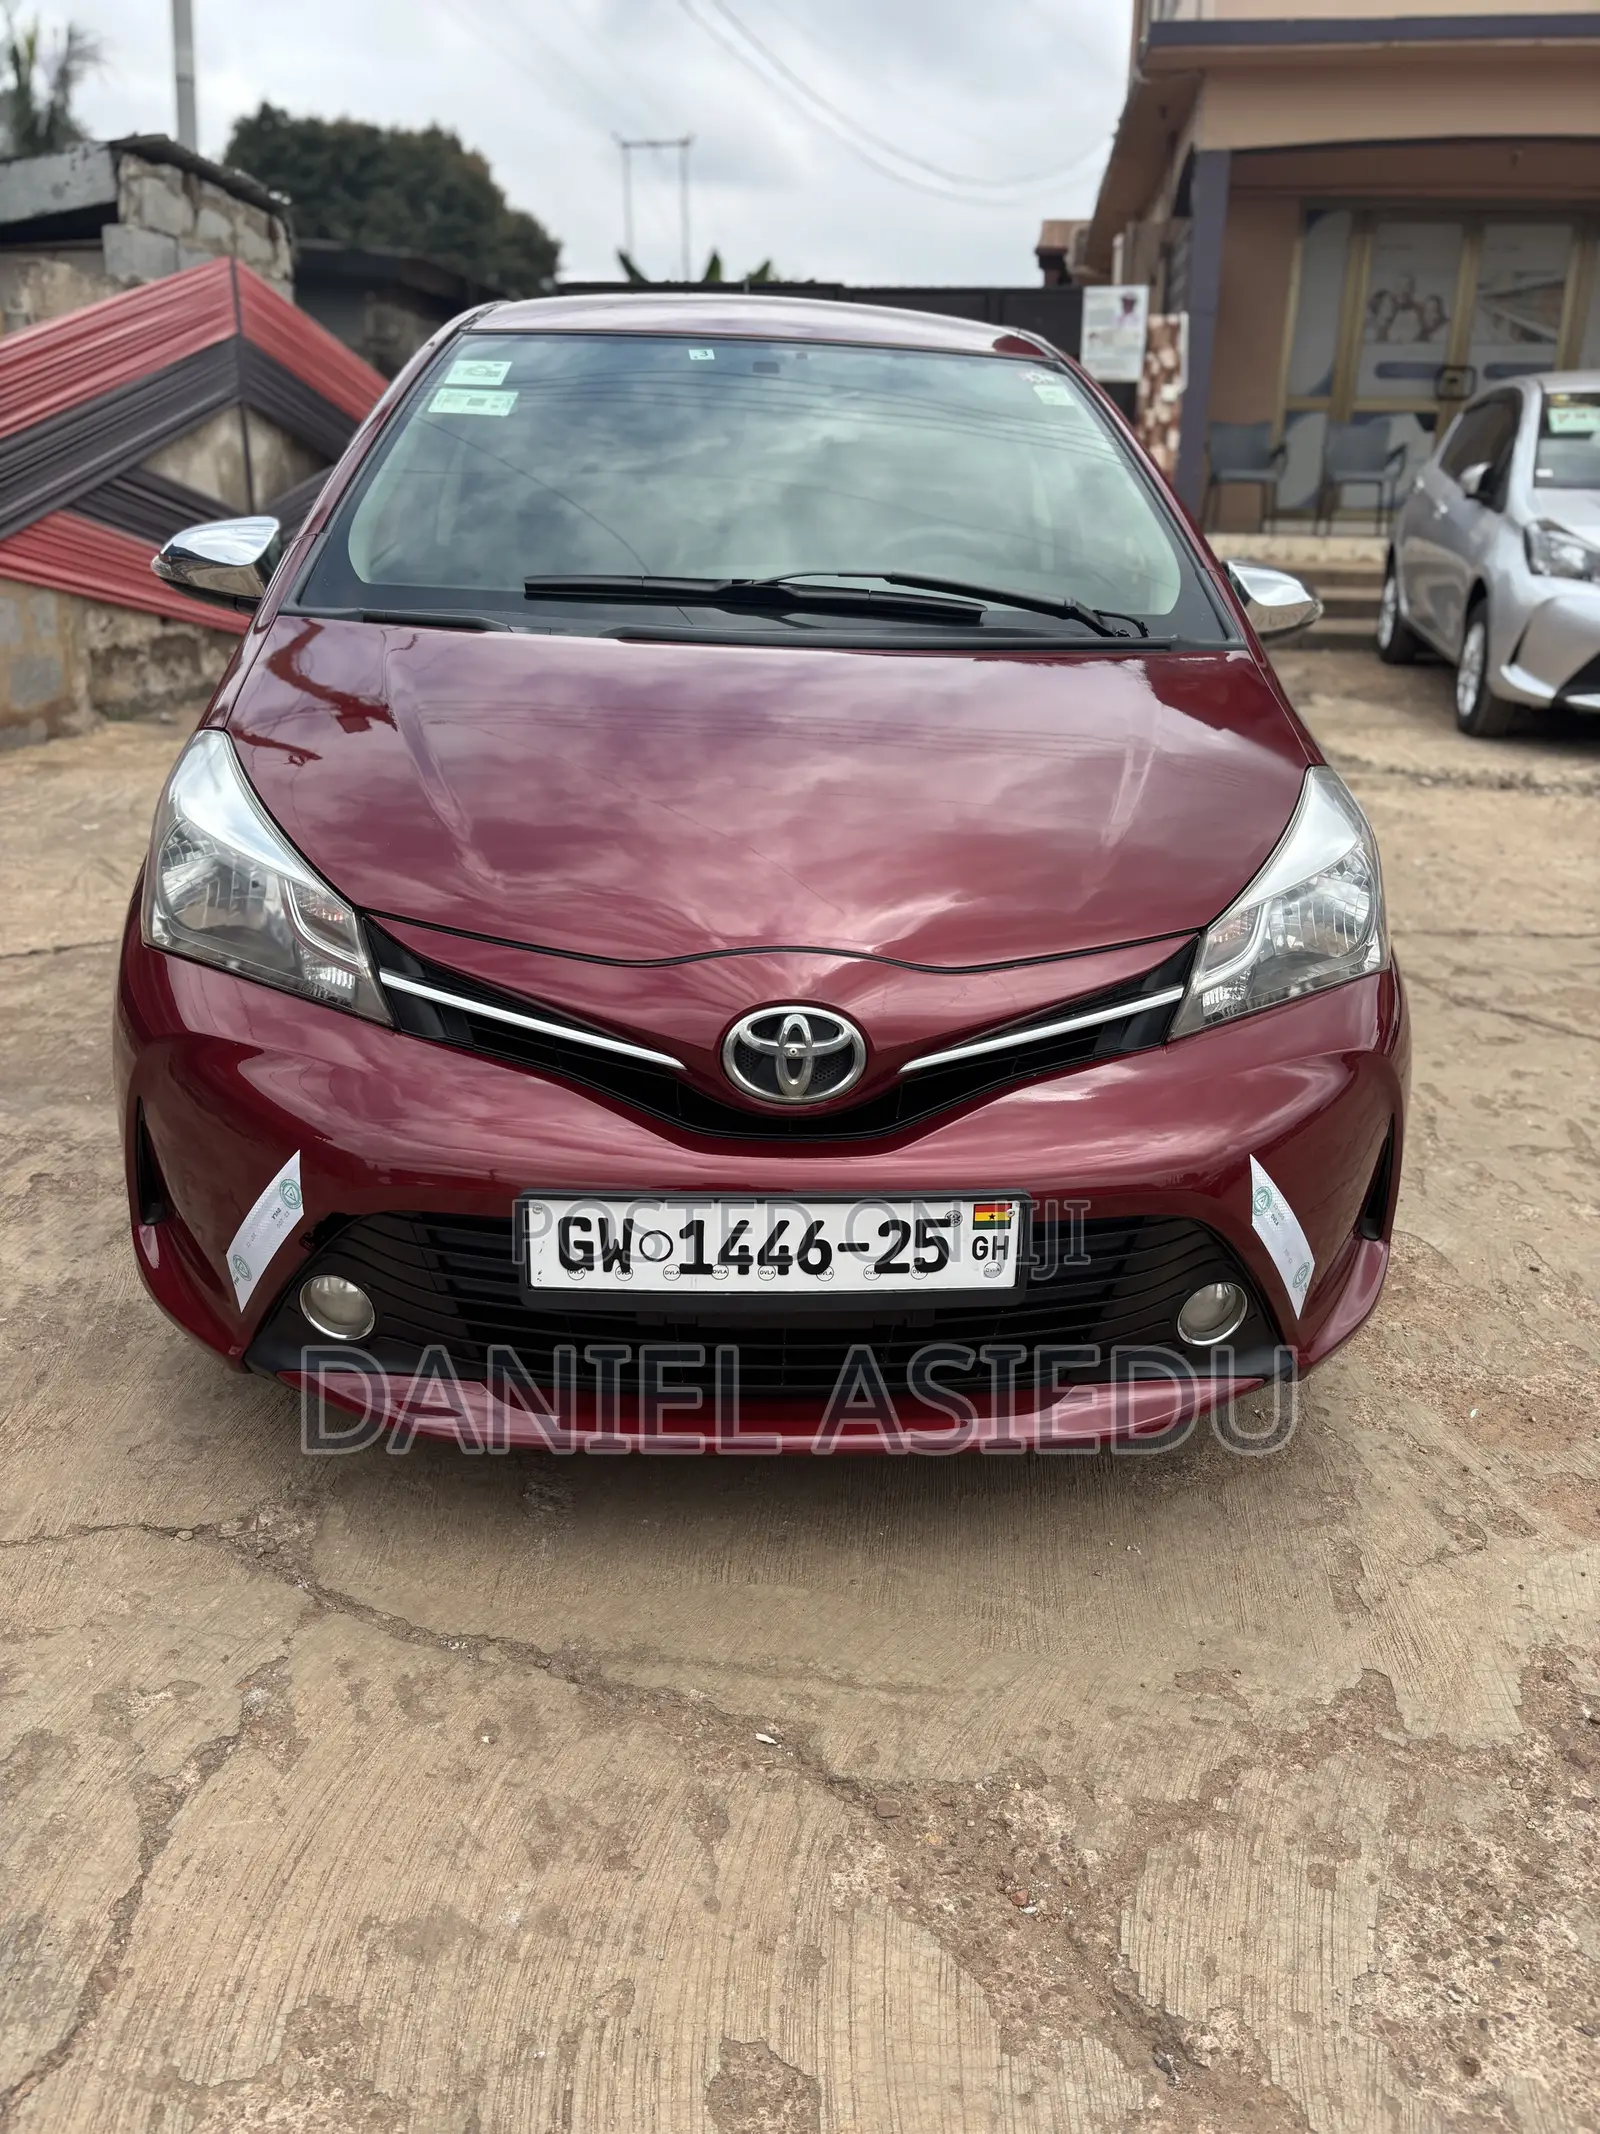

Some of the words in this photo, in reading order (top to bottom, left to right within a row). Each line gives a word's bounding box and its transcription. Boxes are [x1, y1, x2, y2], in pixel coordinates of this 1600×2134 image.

[558, 1216, 634, 1273] GW
[679, 1219, 951, 1275] 1446-25
[972, 1235, 1010, 1261] GH
